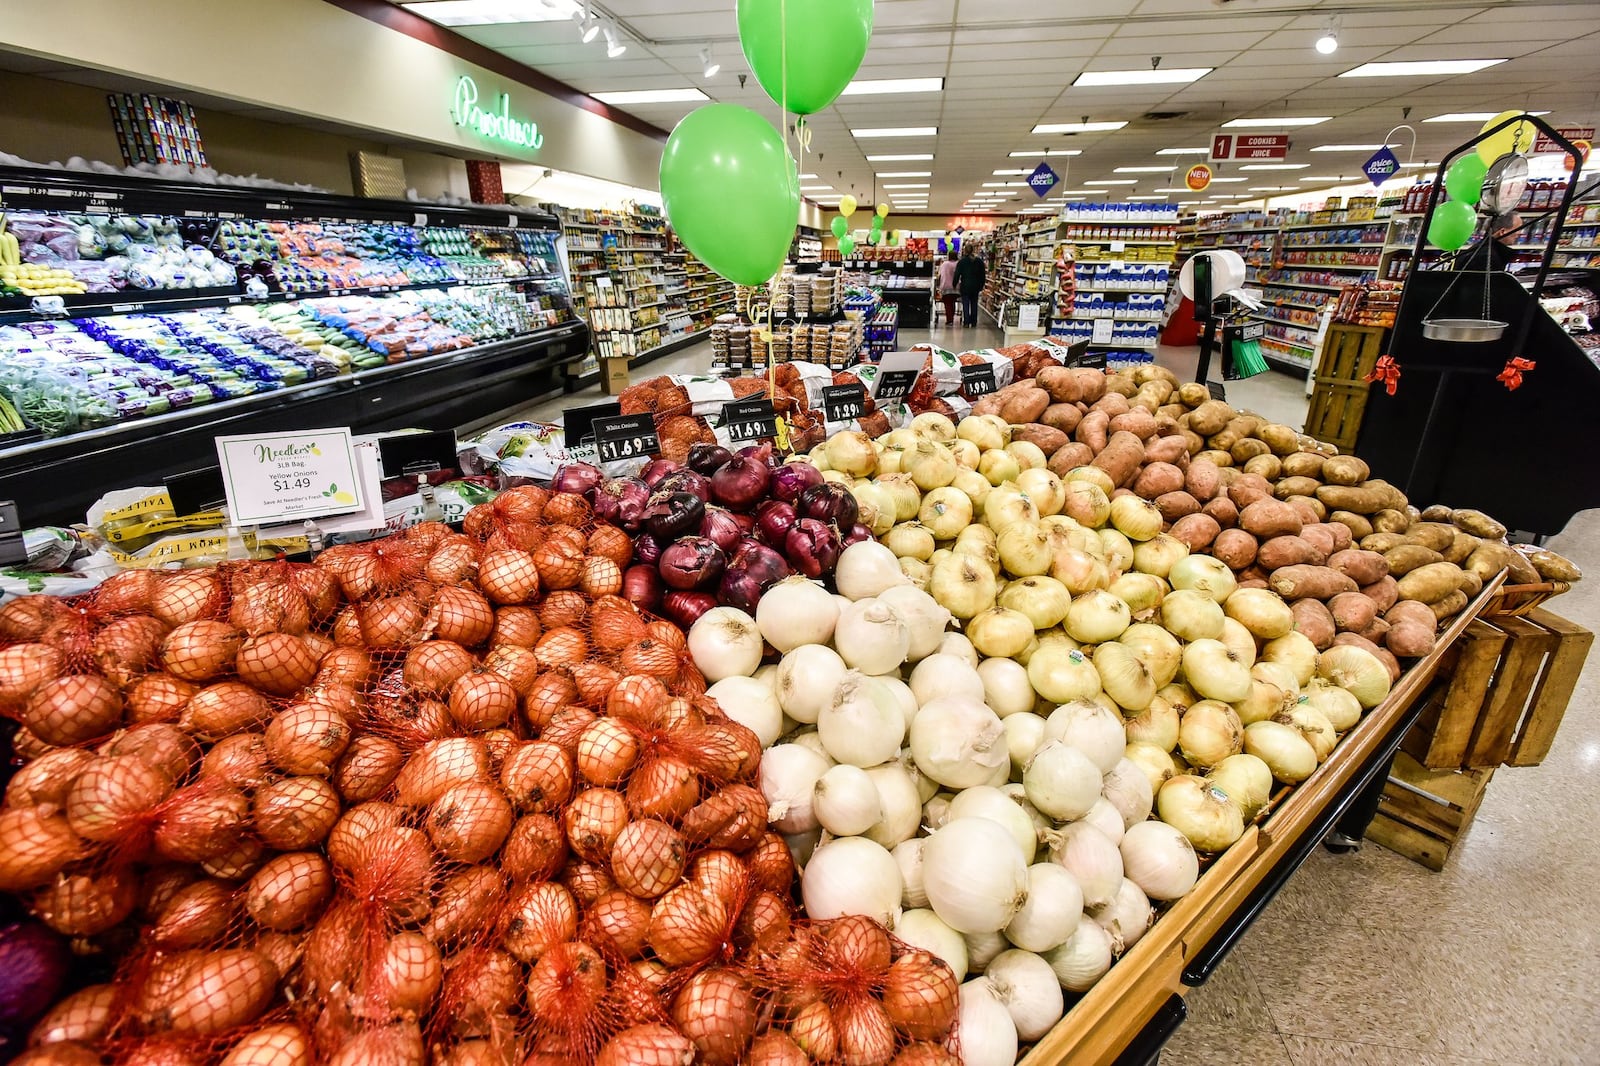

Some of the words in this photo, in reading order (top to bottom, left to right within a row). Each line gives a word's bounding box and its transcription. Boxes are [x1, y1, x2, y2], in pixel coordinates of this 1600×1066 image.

[455, 76, 544, 150] Produce
[1248, 137, 1277, 146] COOKIES
[1218, 139, 1225, 156] 1
[1250, 149, 1271, 158] JUICE
[1370, 158, 1394, 169] price
[1189, 170, 1210, 179] NEW
[605, 424, 621, 432] White
[730, 422, 761, 439] $1.69
[602, 438, 643, 458] $1.69
[293, 470, 318, 478] Onions
[273, 477, 311, 492] $1.49
